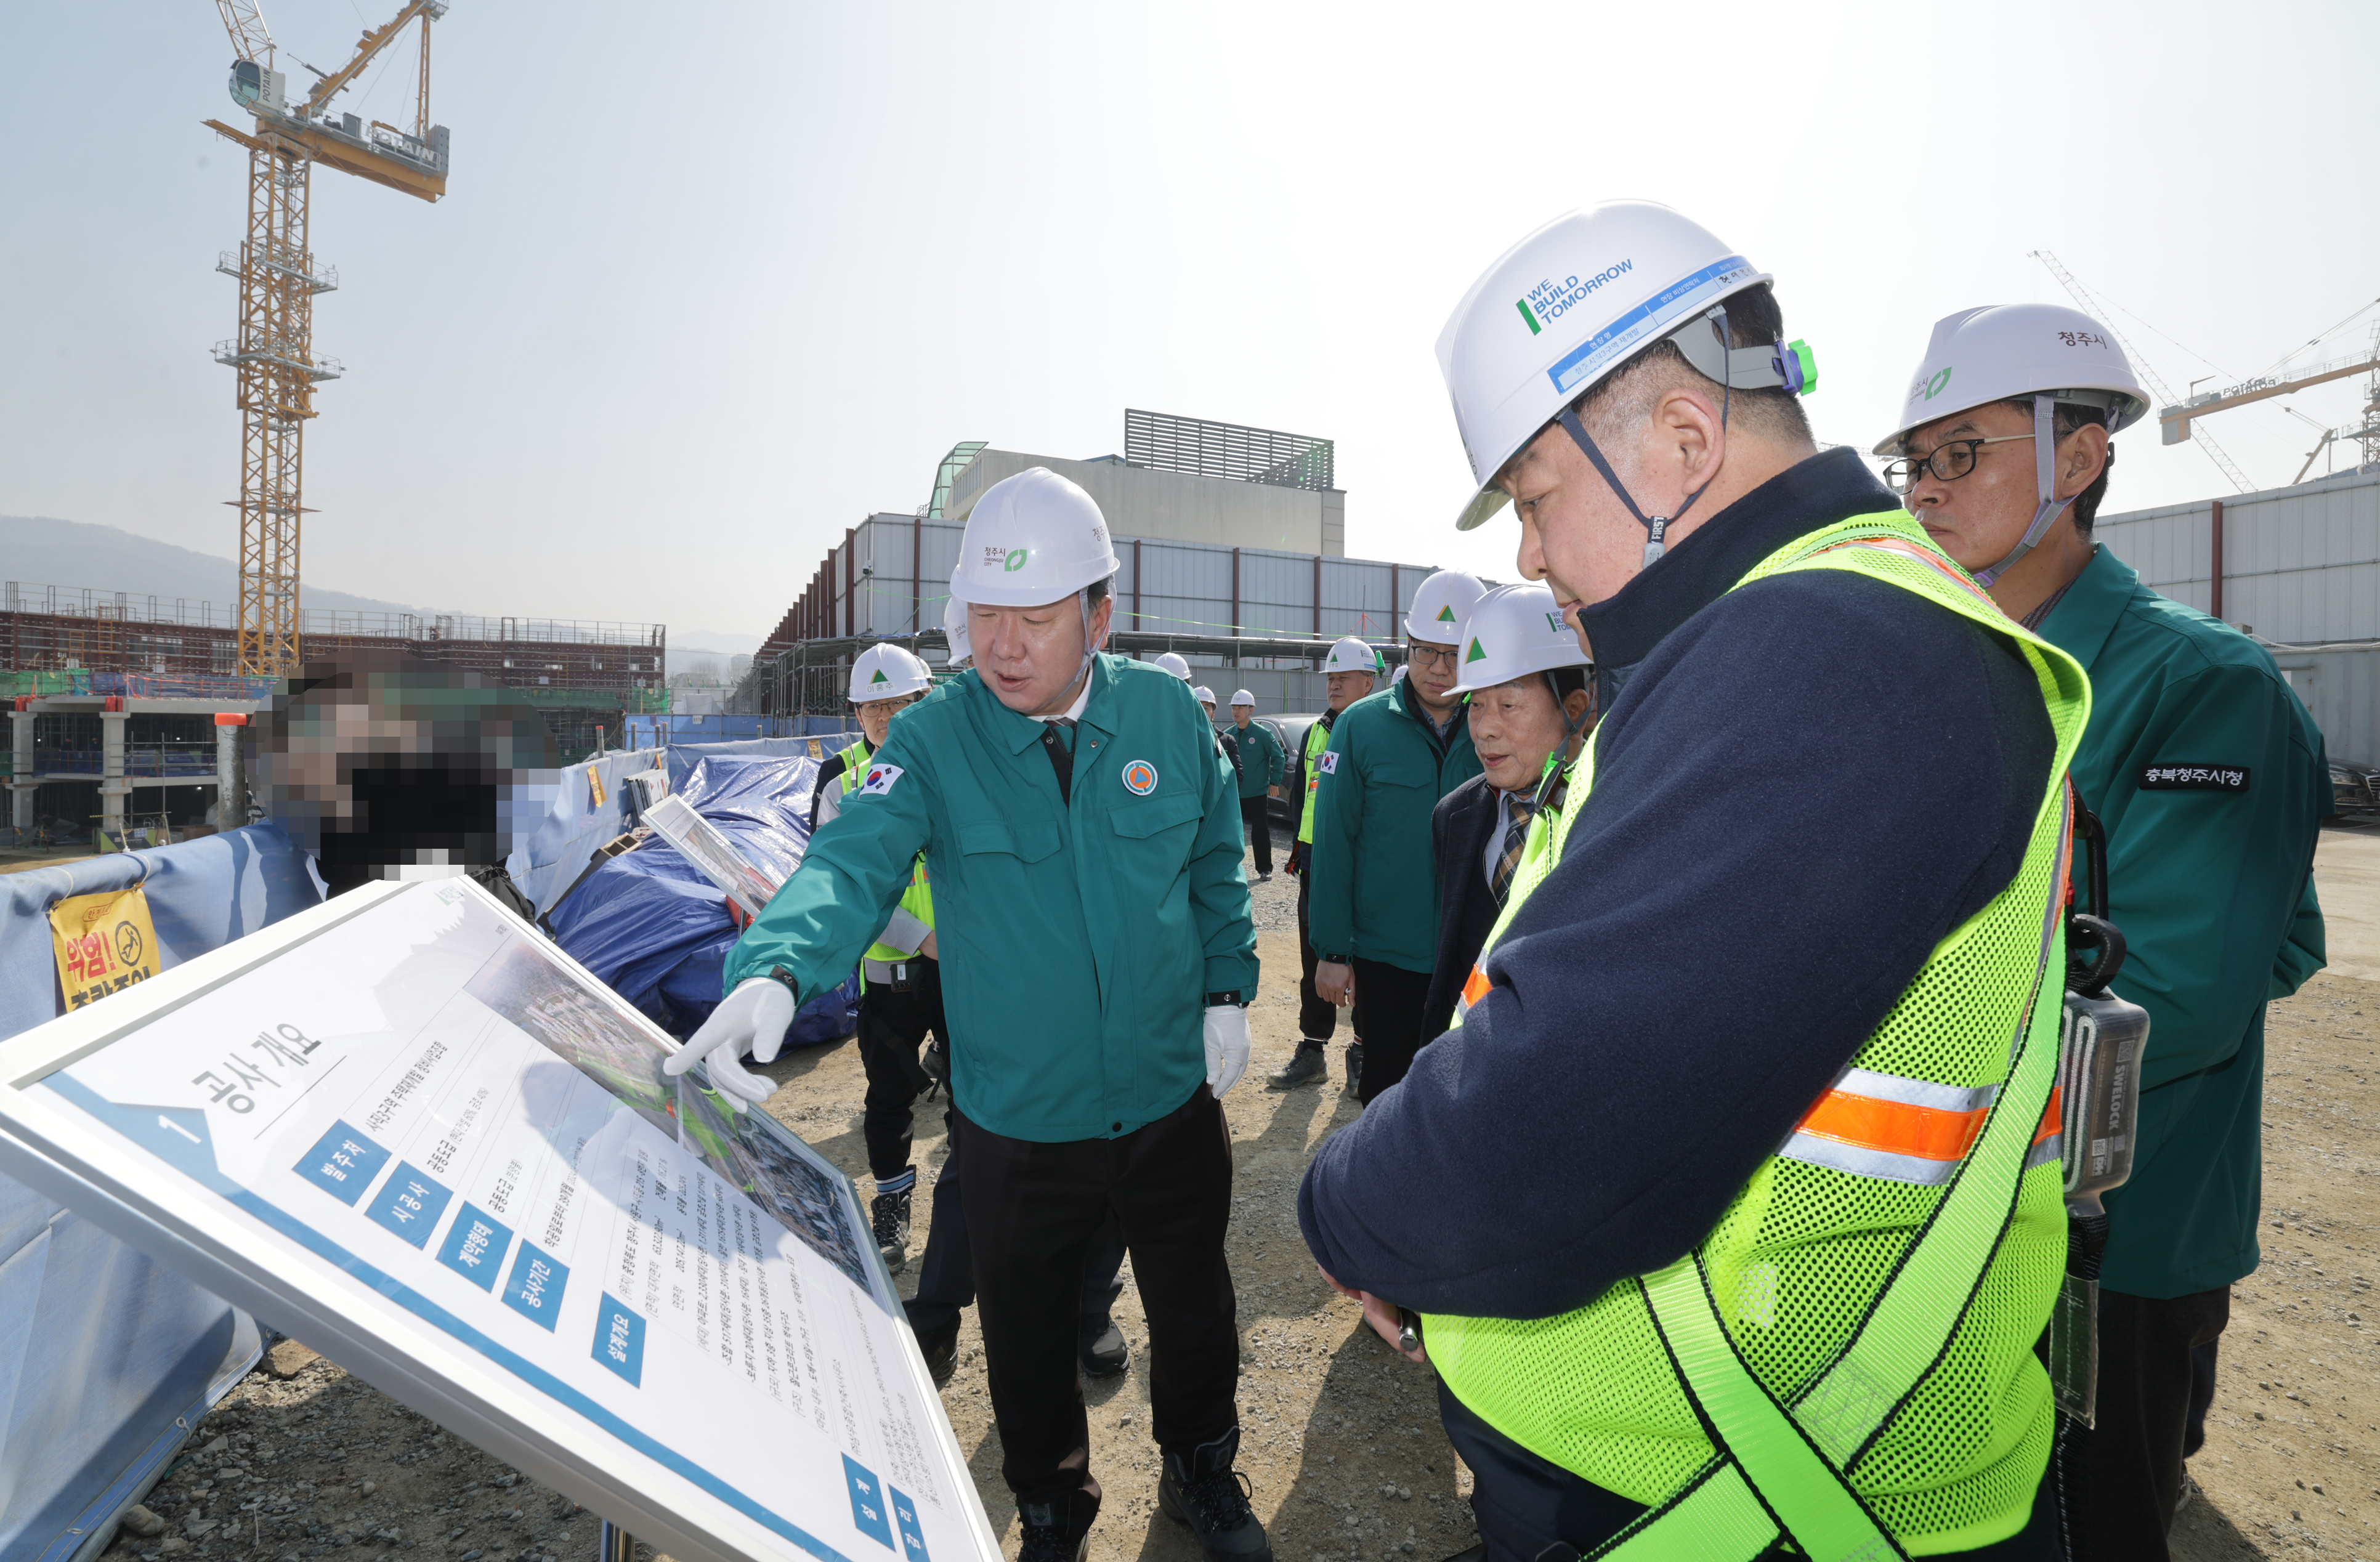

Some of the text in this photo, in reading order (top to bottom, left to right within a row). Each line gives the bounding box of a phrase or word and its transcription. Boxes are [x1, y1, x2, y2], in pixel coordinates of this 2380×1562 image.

[263, 68, 271, 102] POTAIN
[366, 126, 437, 162] POTAIN
[1527, 278, 1553, 301] WE
[1533, 275, 1579, 315] BUILD
[1541, 259, 1632, 324] TOMORROW
[1660, 277, 1700, 303] 현장 비상연락처
[1619, 328, 1640, 344] 재개발
[2058, 331, 2107, 349] 청주시
[1651, 516, 1664, 539] FIRST
[985, 547, 1006, 557] 청주시
[2146, 768, 2243, 786] 충북청주시청
[67, 931, 116, 982] 위험!
[193, 1024, 322, 1114] 공사 개요
[366, 1041, 448, 1131] 사직3구역 주택재개발 정비사업조합
[2108, 1064, 2125, 1131] SWELOCK
[159, 1115, 201, 1143] 1
[427, 1139, 456, 1173] 공동도급
[636, 1175, 645, 1188] 215
[655, 1180, 666, 1200] 건폐율
[488, 1178, 514, 1213] 공동도급
[633, 1185, 644, 1205] 사직동
[676, 1196, 687, 1215] 용적률
[697, 1194, 706, 1217] 금호건설
[544, 1205, 564, 1247] 착공일로부터
[559, 1182, 574, 1206] 39개월
[629, 1203, 641, 1221] 서원구
[459, 1221, 493, 1266] 계약형태
[626, 1226, 638, 1245] 청주시
[751, 1223, 761, 1246] 금호건설
[622, 1244, 636, 1276] 충청북도
[786, 1253, 795, 1266] 도장
[522, 1259, 550, 1308] 공사기간
[618, 1274, 634, 1300] [위치]
[647, 1261, 661, 1292] 대지면적
[645, 1292, 660, 1317] [면적]
[672, 1286, 684, 1311] 연면적
[608, 1314, 628, 1362] 설계개요
[697, 1325, 710, 1352] [세대]
[764, 1324, 774, 1341] 지상
[765, 1341, 775, 1357] 3층
[767, 1356, 777, 1374] 지하
[780, 1310, 806, 1417] [구조] 철근콘크리트 벽식구조
[769, 1374, 782, 1402] [규모]
[811, 1386, 822, 1405] 내부
[814, 1406, 828, 1433] [마감]
